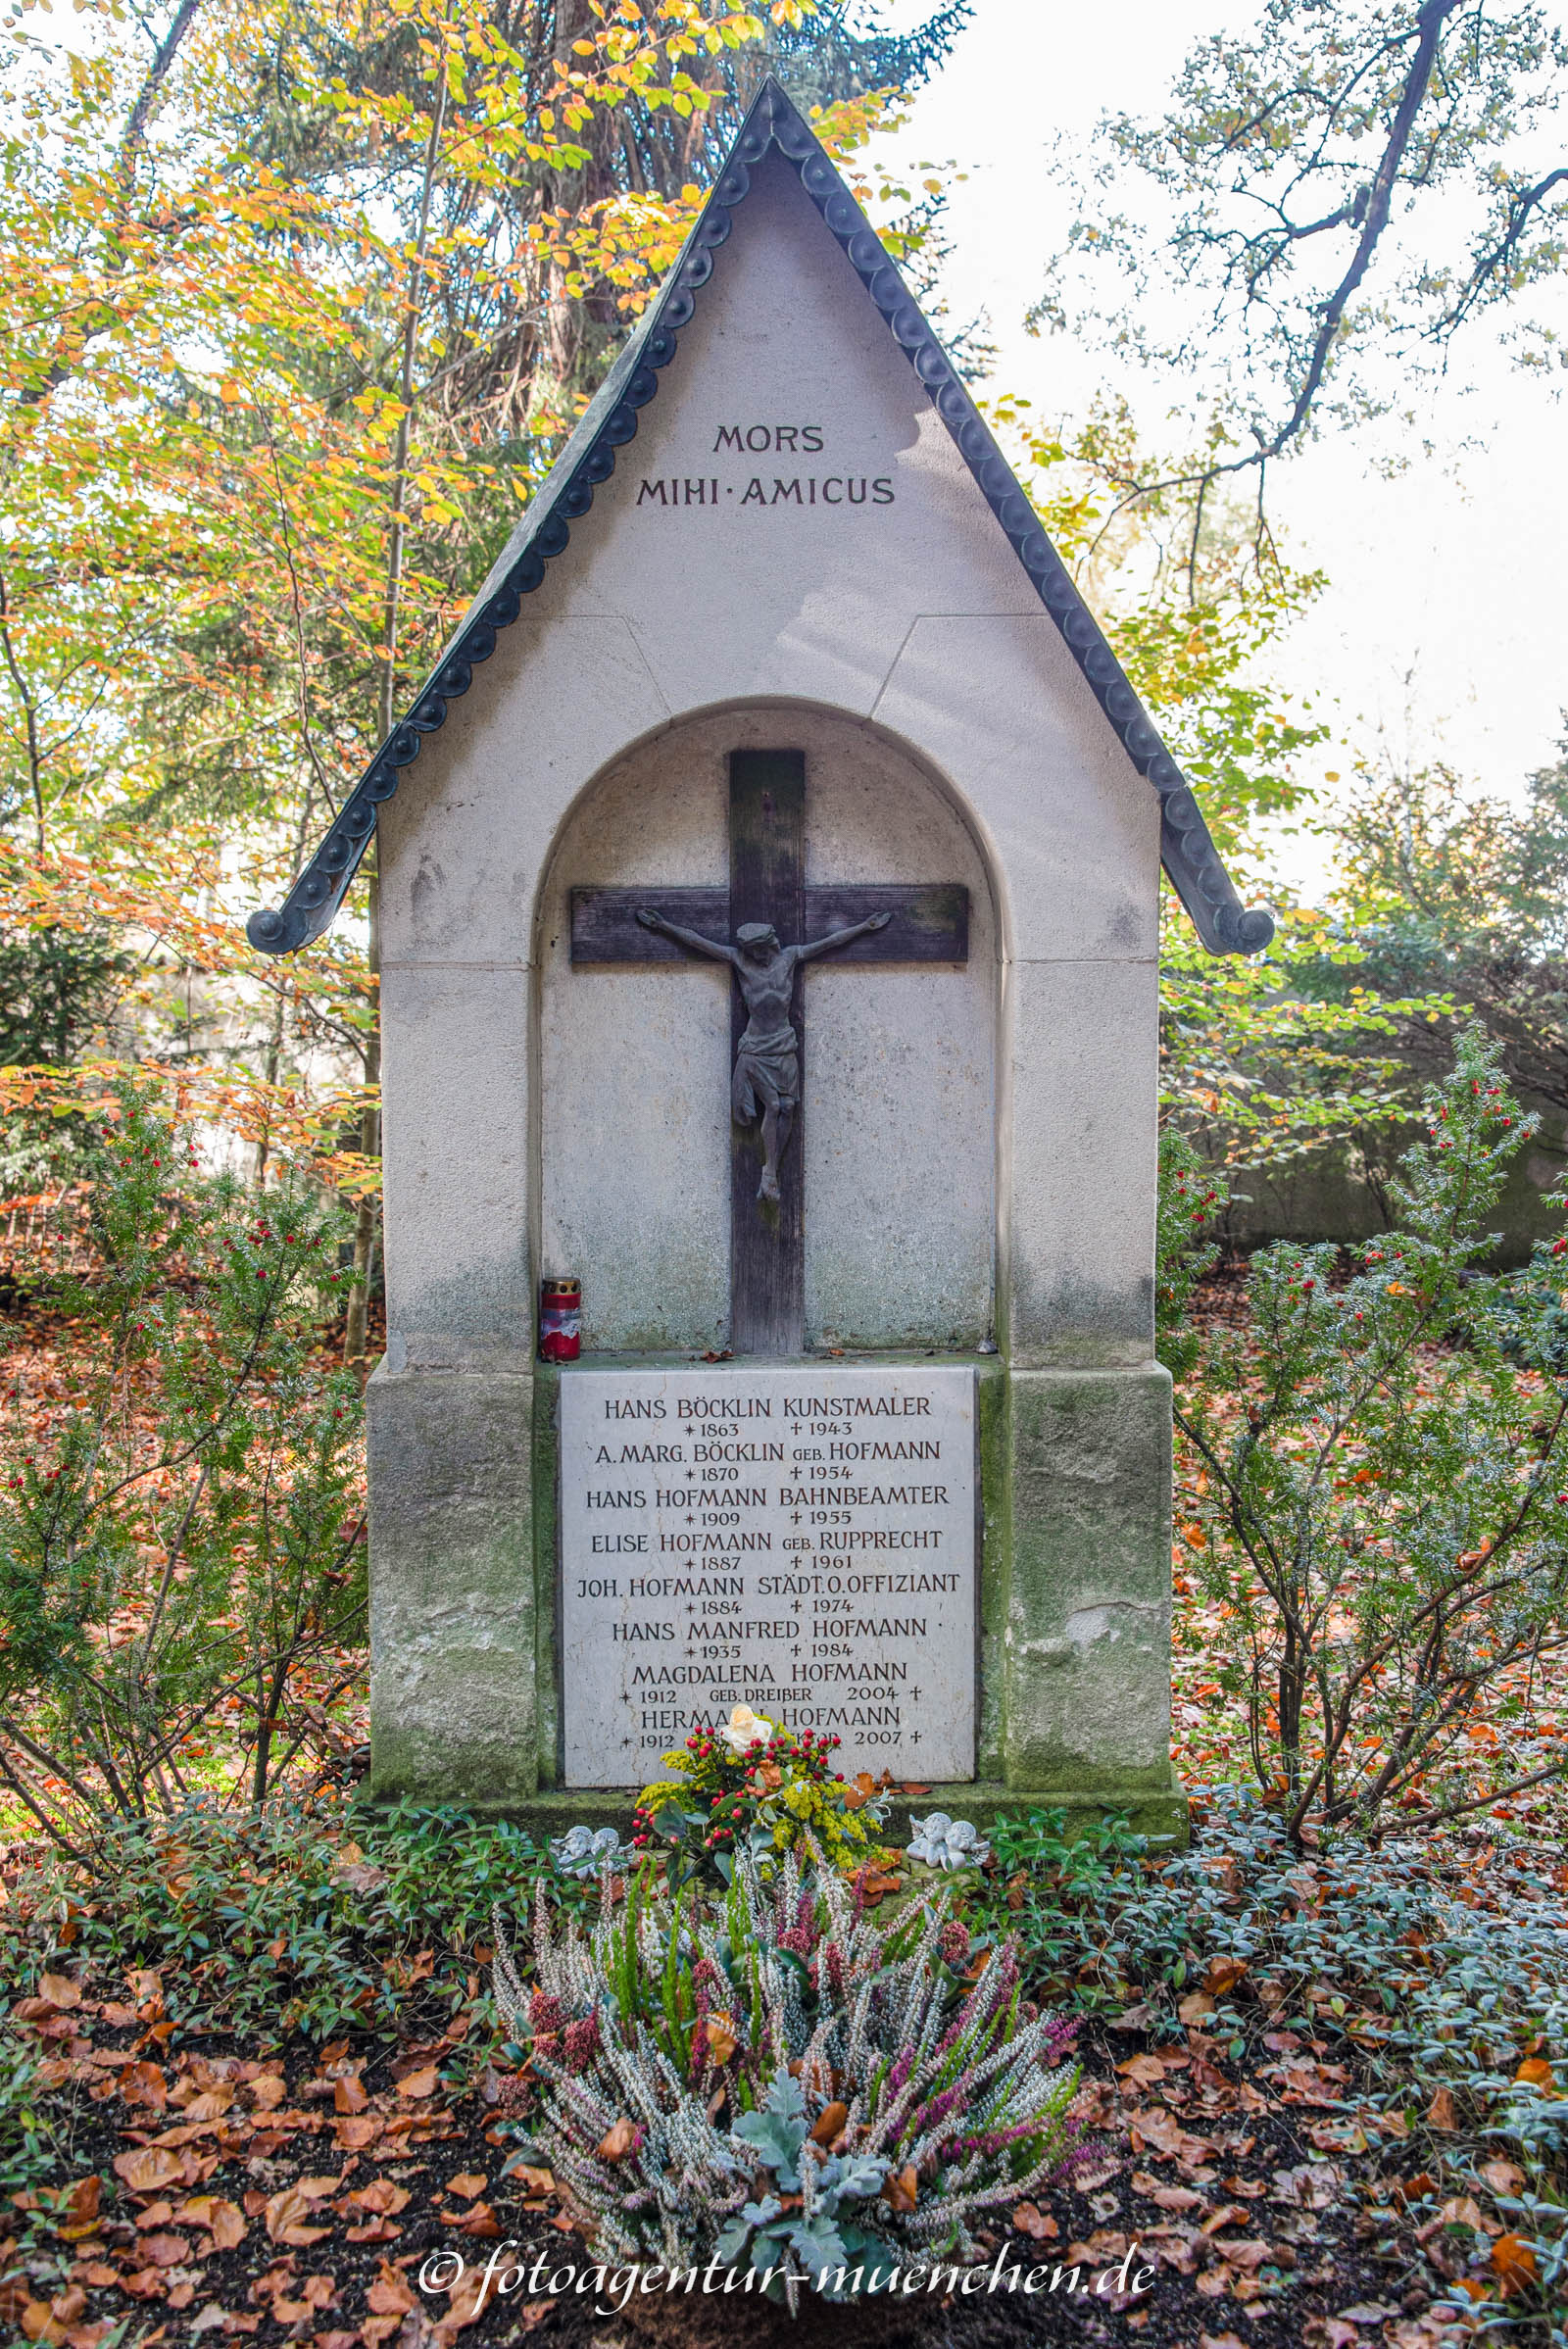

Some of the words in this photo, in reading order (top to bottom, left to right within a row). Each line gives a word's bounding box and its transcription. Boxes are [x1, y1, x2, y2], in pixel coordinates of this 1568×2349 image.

[712, 424, 824, 453] MORS
[605, 1399, 667, 1420] HANS
[677, 1395, 772, 1419] BÖCKLIN
[783, 1396, 932, 1418] KUNSTMALER
[701, 1423, 739, 1438] 1863
[809, 1421, 853, 1437] 1943
[694, 1442, 784, 1462] BÖCKLIN
[793, 1447, 825, 1461] GEB.
[829, 1441, 941, 1460] HOFMANN
[702, 1467, 739, 1482] 1870
[809, 1465, 854, 1480] 1954
[587, 1490, 647, 1508] HANS
[656, 1488, 766, 1507] HOFMANN
[779, 1486, 950, 1506] BAHNBEAMTER
[702, 1512, 741, 1527] 1909
[810, 1510, 852, 1525] 1955
[592, 1534, 649, 1553] ELISE
[660, 1532, 771, 1552] HOFMANN
[782, 1538, 815, 1551] GEB.
[819, 1530, 943, 1550] RUPPRECHT
[702, 1556, 742, 1571] 1887
[812, 1555, 852, 1569] 1961
[577, 1579, 624, 1598] JOH.
[629, 1577, 744, 1597] HOFMANN
[702, 1600, 742, 1615] 1884
[812, 1598, 855, 1613] 1974
[612, 1622, 675, 1641] HANS
[686, 1620, 800, 1640] MANFRED
[812, 1618, 927, 1639] HOFMANN
[703, 1644, 741, 1660] 1935
[811, 1643, 854, 1658] 1984
[631, 1664, 776, 1686] MAGDALENA
[792, 1662, 907, 1683] HOFMANN
[640, 1689, 677, 1704] 1912
[709, 1688, 742, 1703] GEB.
[847, 1686, 900, 1703] 2004
[641, 1709, 763, 1730] HERMA
[782, 1706, 901, 1728] HOFMANN
[641, 1735, 675, 1748] 1912
[855, 1731, 903, 1745] 2007
